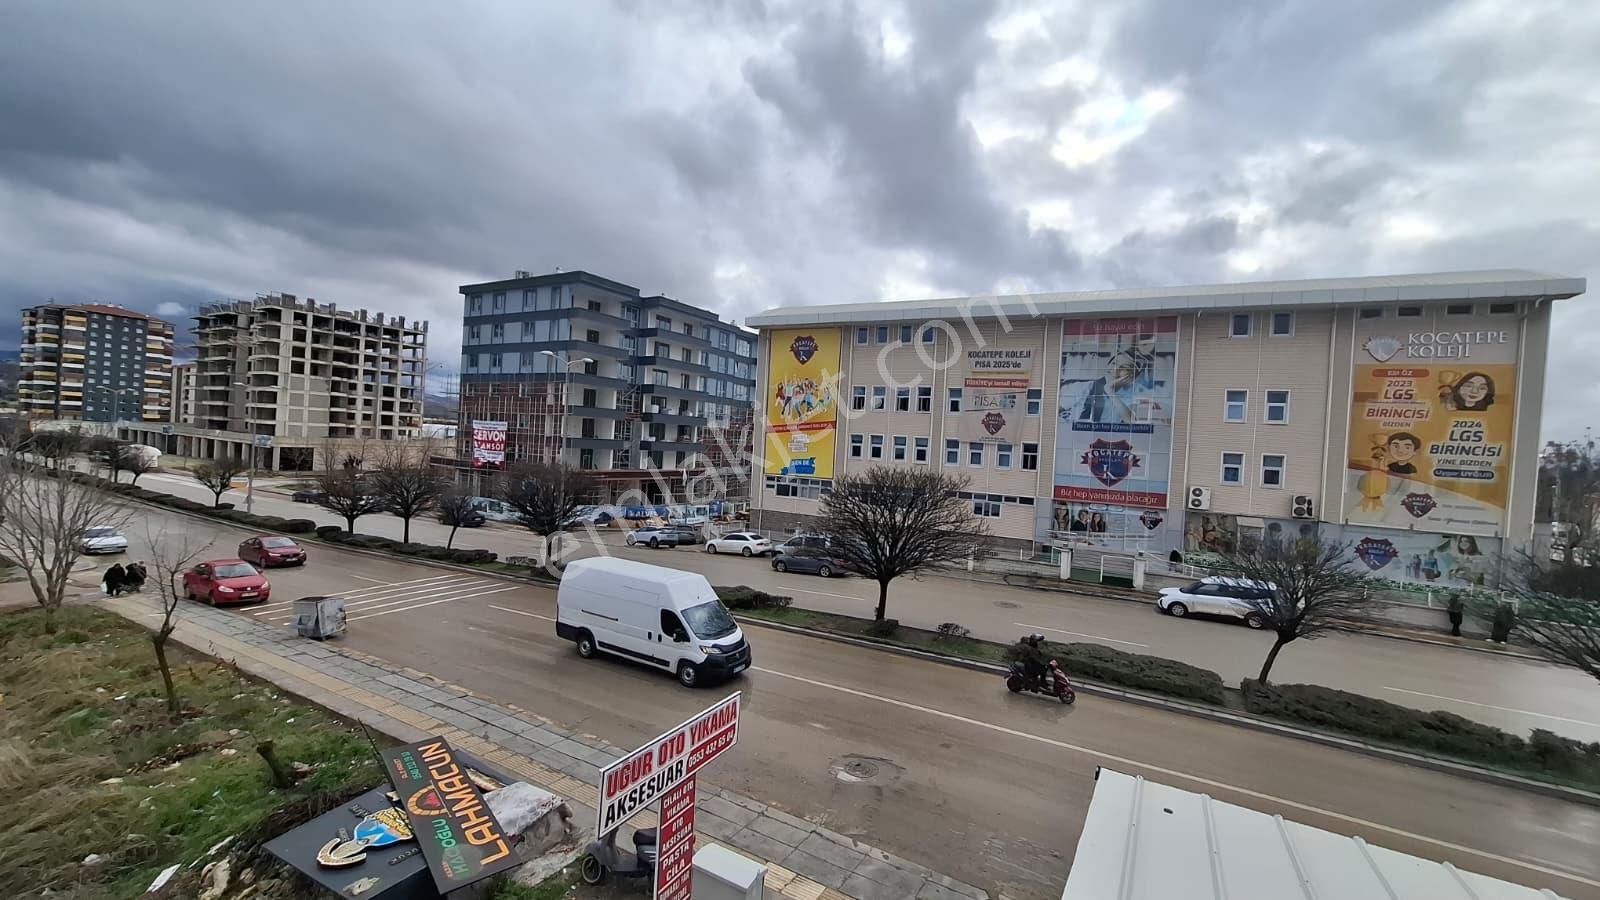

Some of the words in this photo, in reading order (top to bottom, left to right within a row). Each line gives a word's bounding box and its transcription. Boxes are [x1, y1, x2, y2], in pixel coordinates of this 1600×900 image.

[1408, 331, 1508, 344] KOCATEPE
[967, 350, 1004, 359] KOCATEPE
[1384, 388, 1414, 400] LGS
[1366, 406, 1430, 419] BİRİNCİSİ
[1452, 420, 1482, 428] 2024
[1449, 430, 1484, 442] LGS
[1429, 441, 1503, 456] BİRİNCİSİ
[1073, 489, 1088, 499] hep
[658, 729, 685, 767] OTO
[690, 701, 737, 746] YIKAMA
[604, 759, 684, 829] AKSESUAR
[417, 742, 510, 866] LAHMACUN
[666, 796, 690, 819] YIKAMA
[672, 816, 684, 832] OTO
[662, 822, 692, 852] AKSESUAR
[662, 841, 689, 870] PASTA
